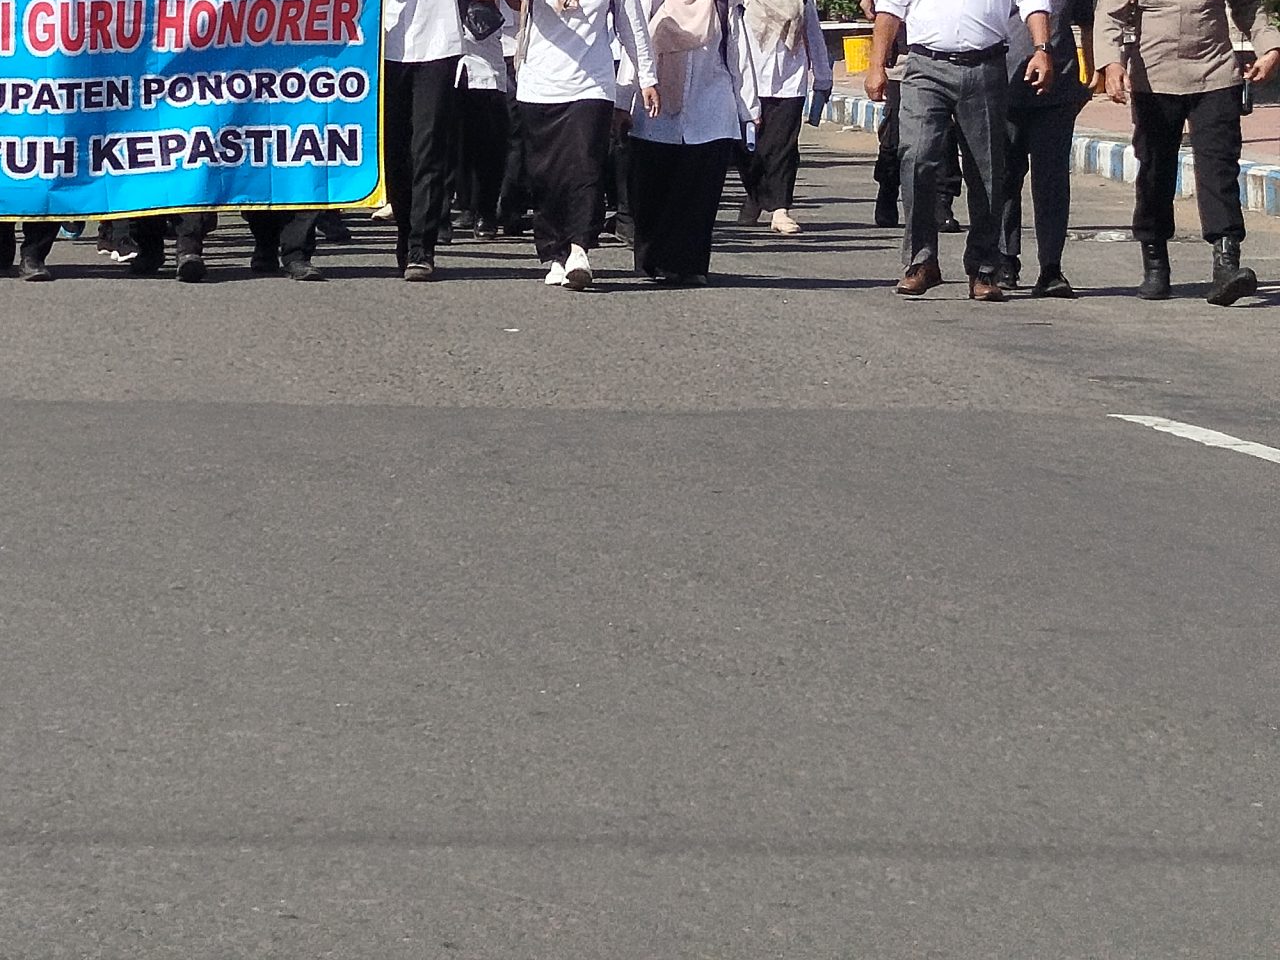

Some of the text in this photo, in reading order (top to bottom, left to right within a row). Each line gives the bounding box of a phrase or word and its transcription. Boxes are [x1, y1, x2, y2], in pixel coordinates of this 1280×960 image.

[26, 0, 144, 53] GURU
[143, 71, 366, 105] PONOROGO
[92, 128, 360, 172] KEPASTIAN
